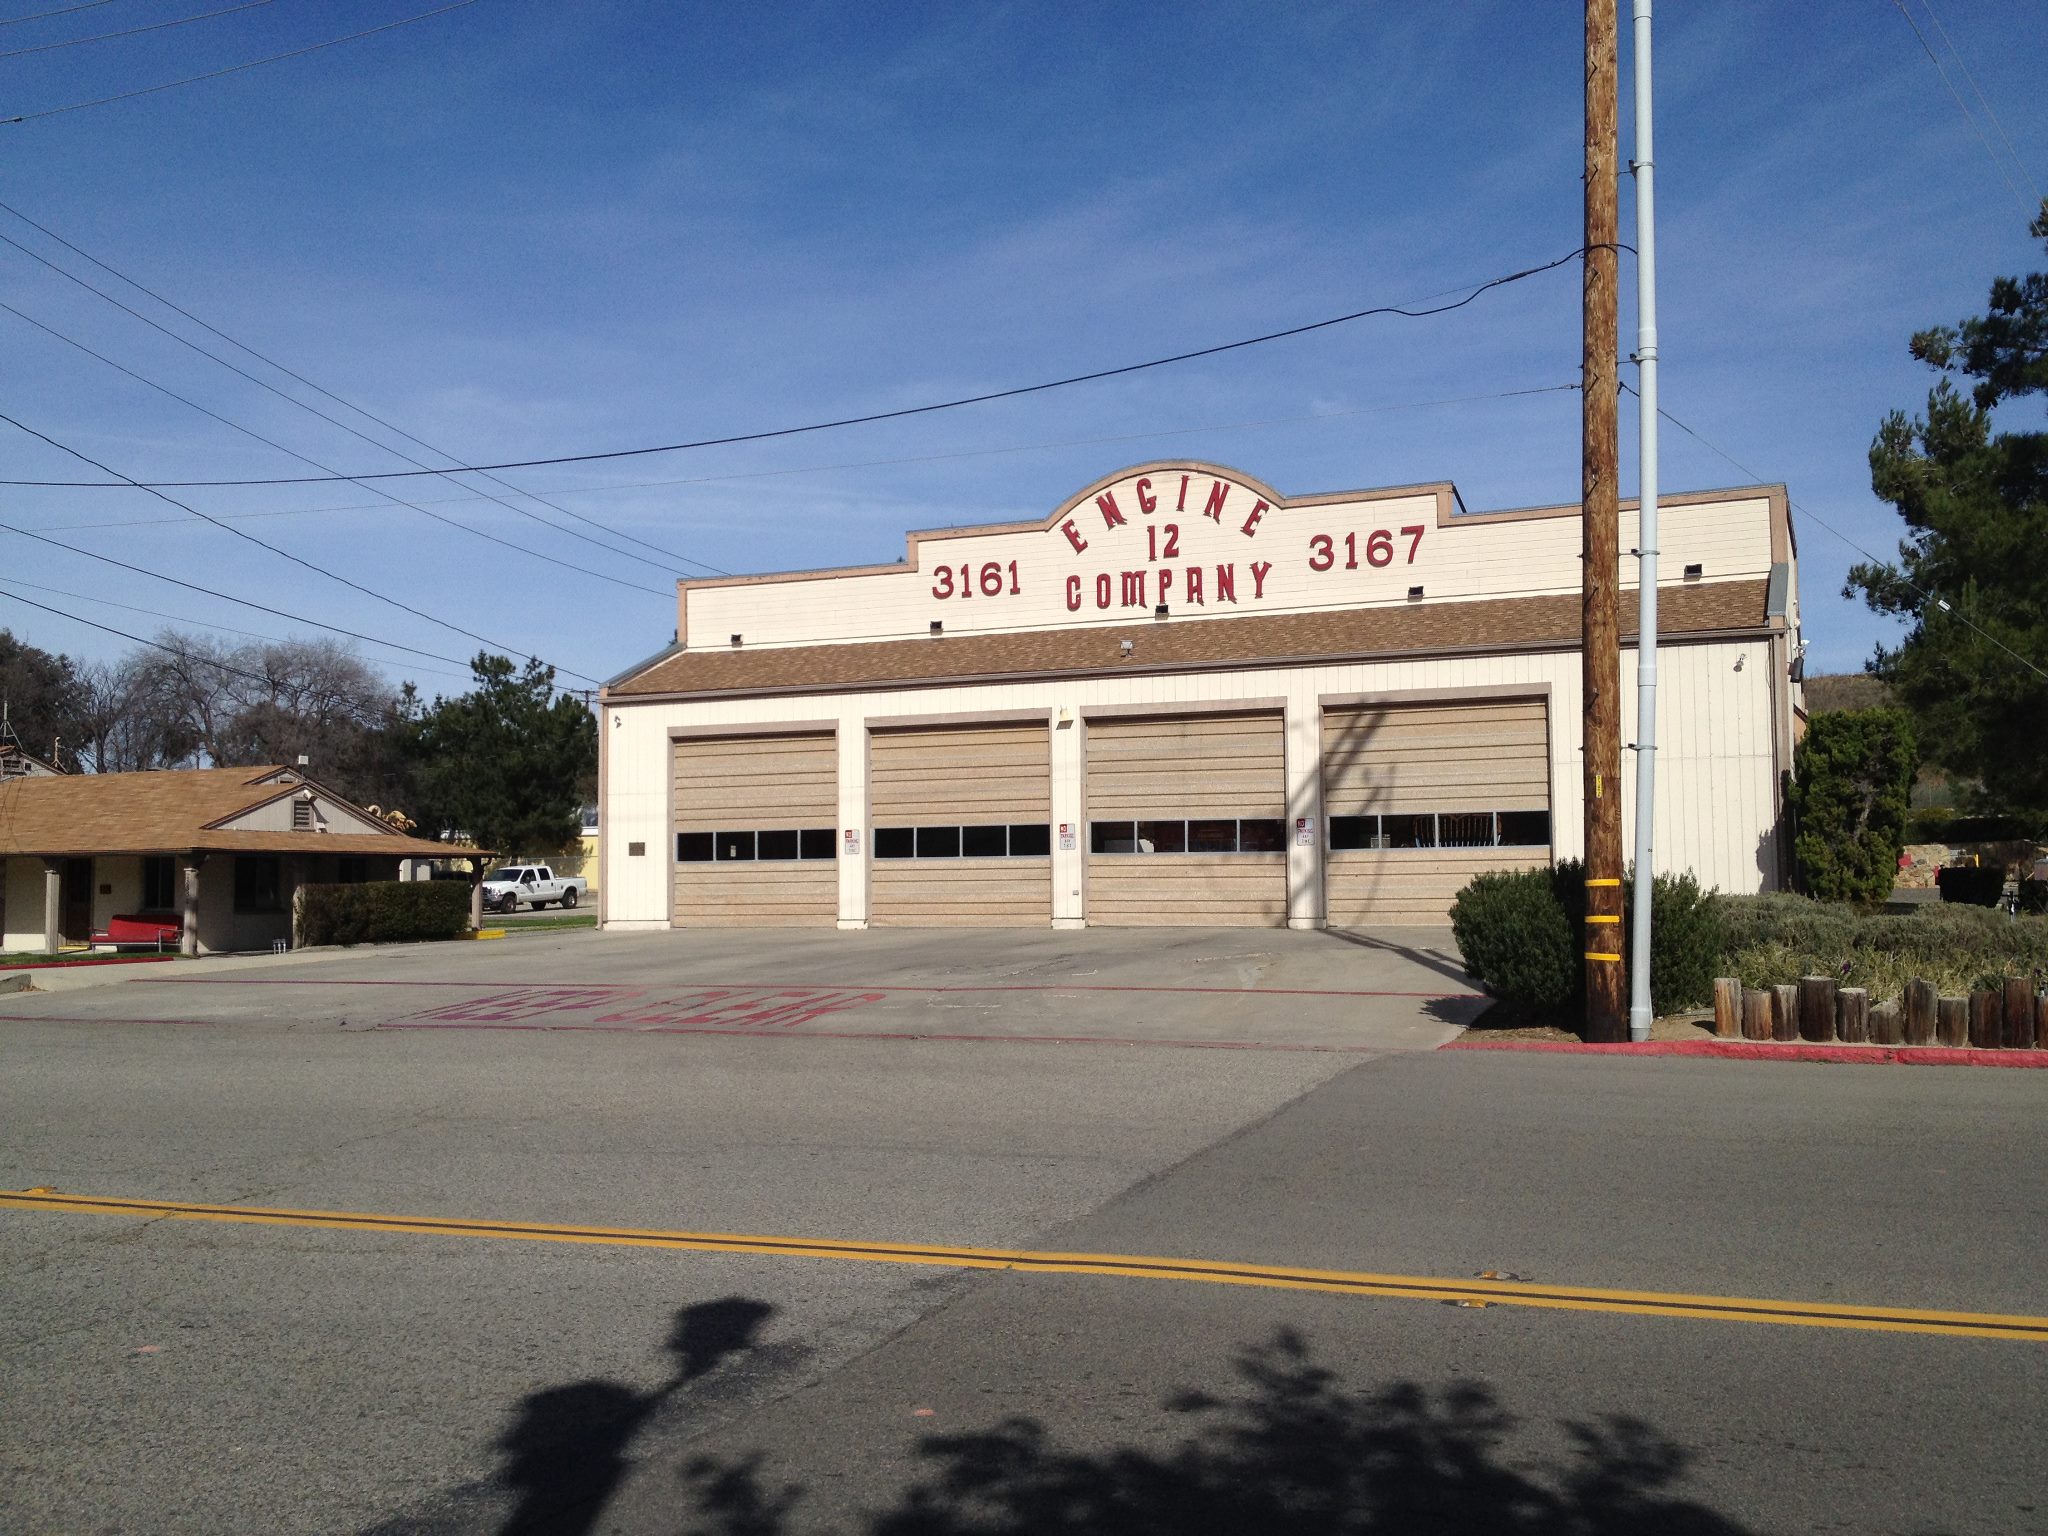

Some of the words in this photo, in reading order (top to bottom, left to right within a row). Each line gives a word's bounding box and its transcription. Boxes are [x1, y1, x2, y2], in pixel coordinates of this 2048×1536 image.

[1060, 475, 1270, 555] ENGINE
[1147, 523, 1180, 561] 12
[1308, 525, 1425, 572] 3167
[932, 560, 1021, 599] 3161
[1066, 561, 1272, 612] COMPANY
[388, 989, 645, 1022] KEEP
[593, 991, 887, 1028] CLEAR
